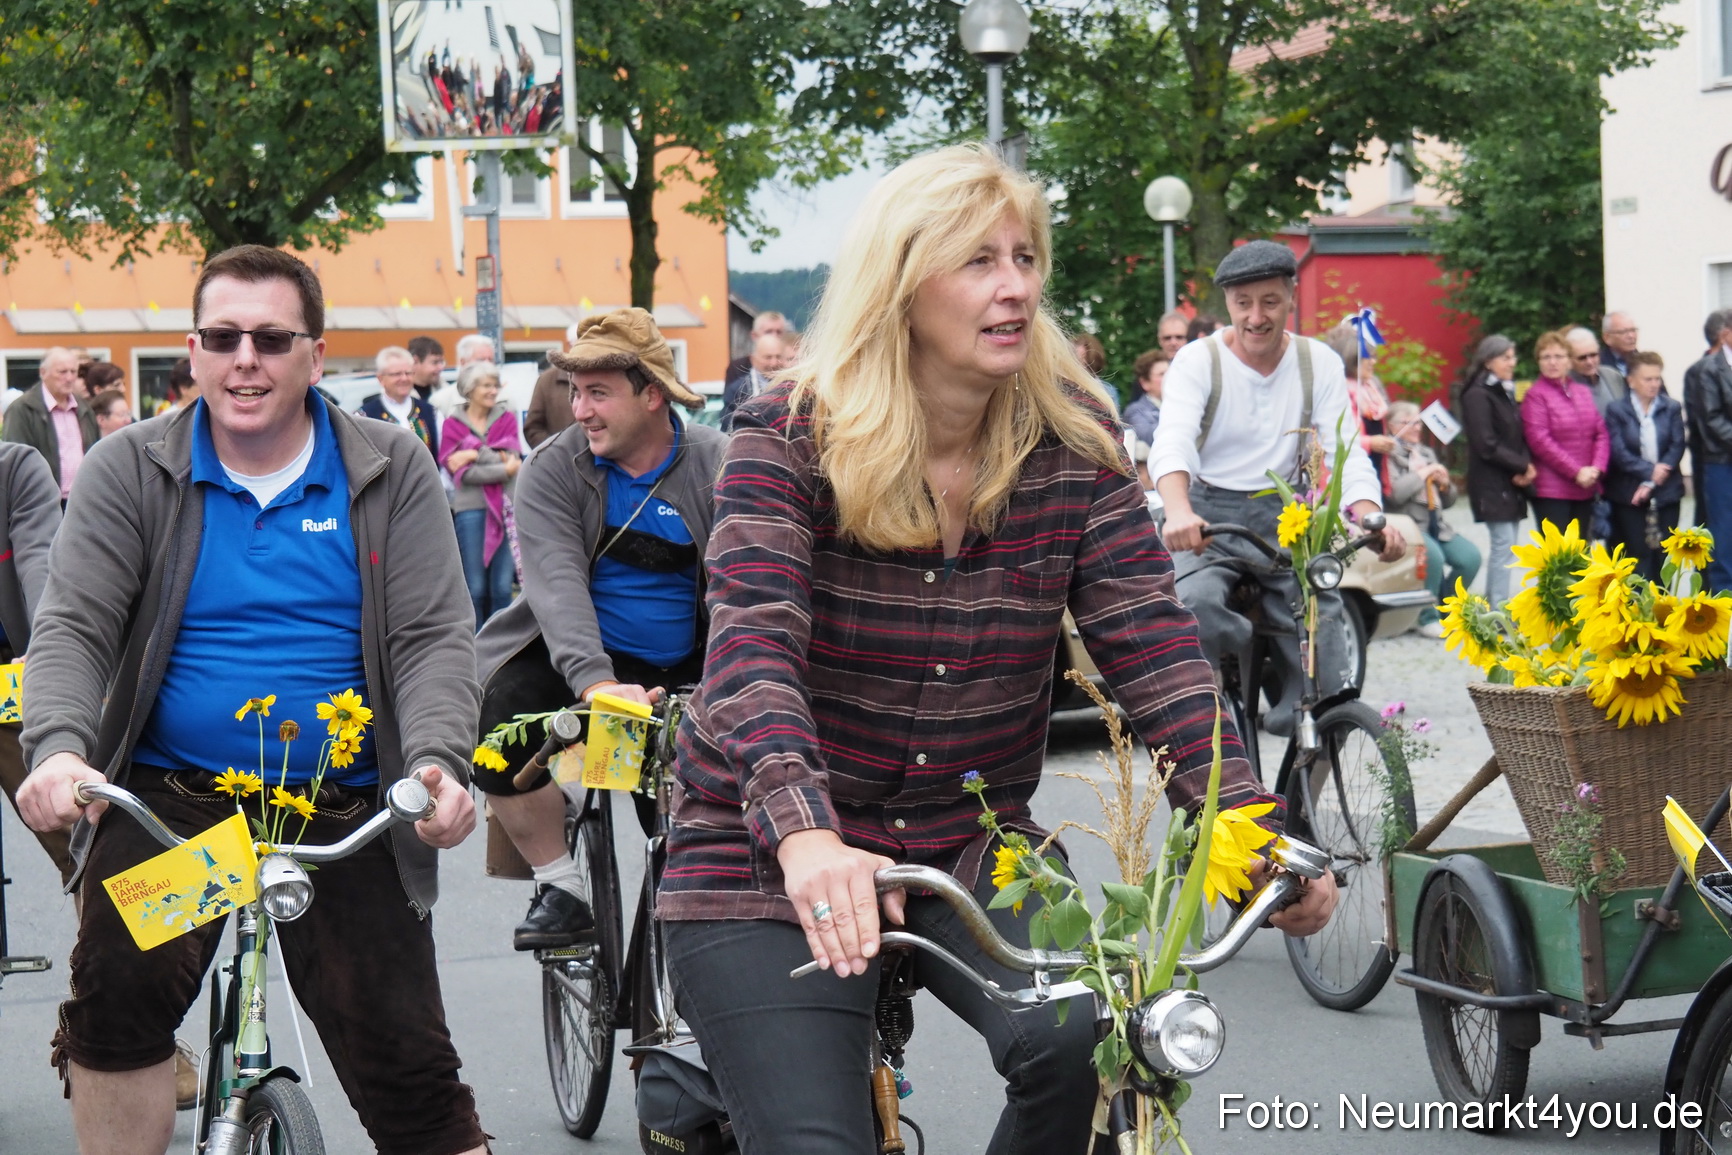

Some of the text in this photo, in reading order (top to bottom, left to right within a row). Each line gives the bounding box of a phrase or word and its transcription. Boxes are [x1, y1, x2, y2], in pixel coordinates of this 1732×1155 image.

[302, 517, 337, 532] Rudi
[586, 770, 594, 784] 875
[593, 760, 601, 785] JAHRE
[599, 747, 610, 785] BERNGAU
[110, 877, 131, 892] 875
[115, 879, 149, 902] JAHRE
[119, 878, 172, 908] BERNGAU
[650, 1129, 685, 1153] EXPRESS
